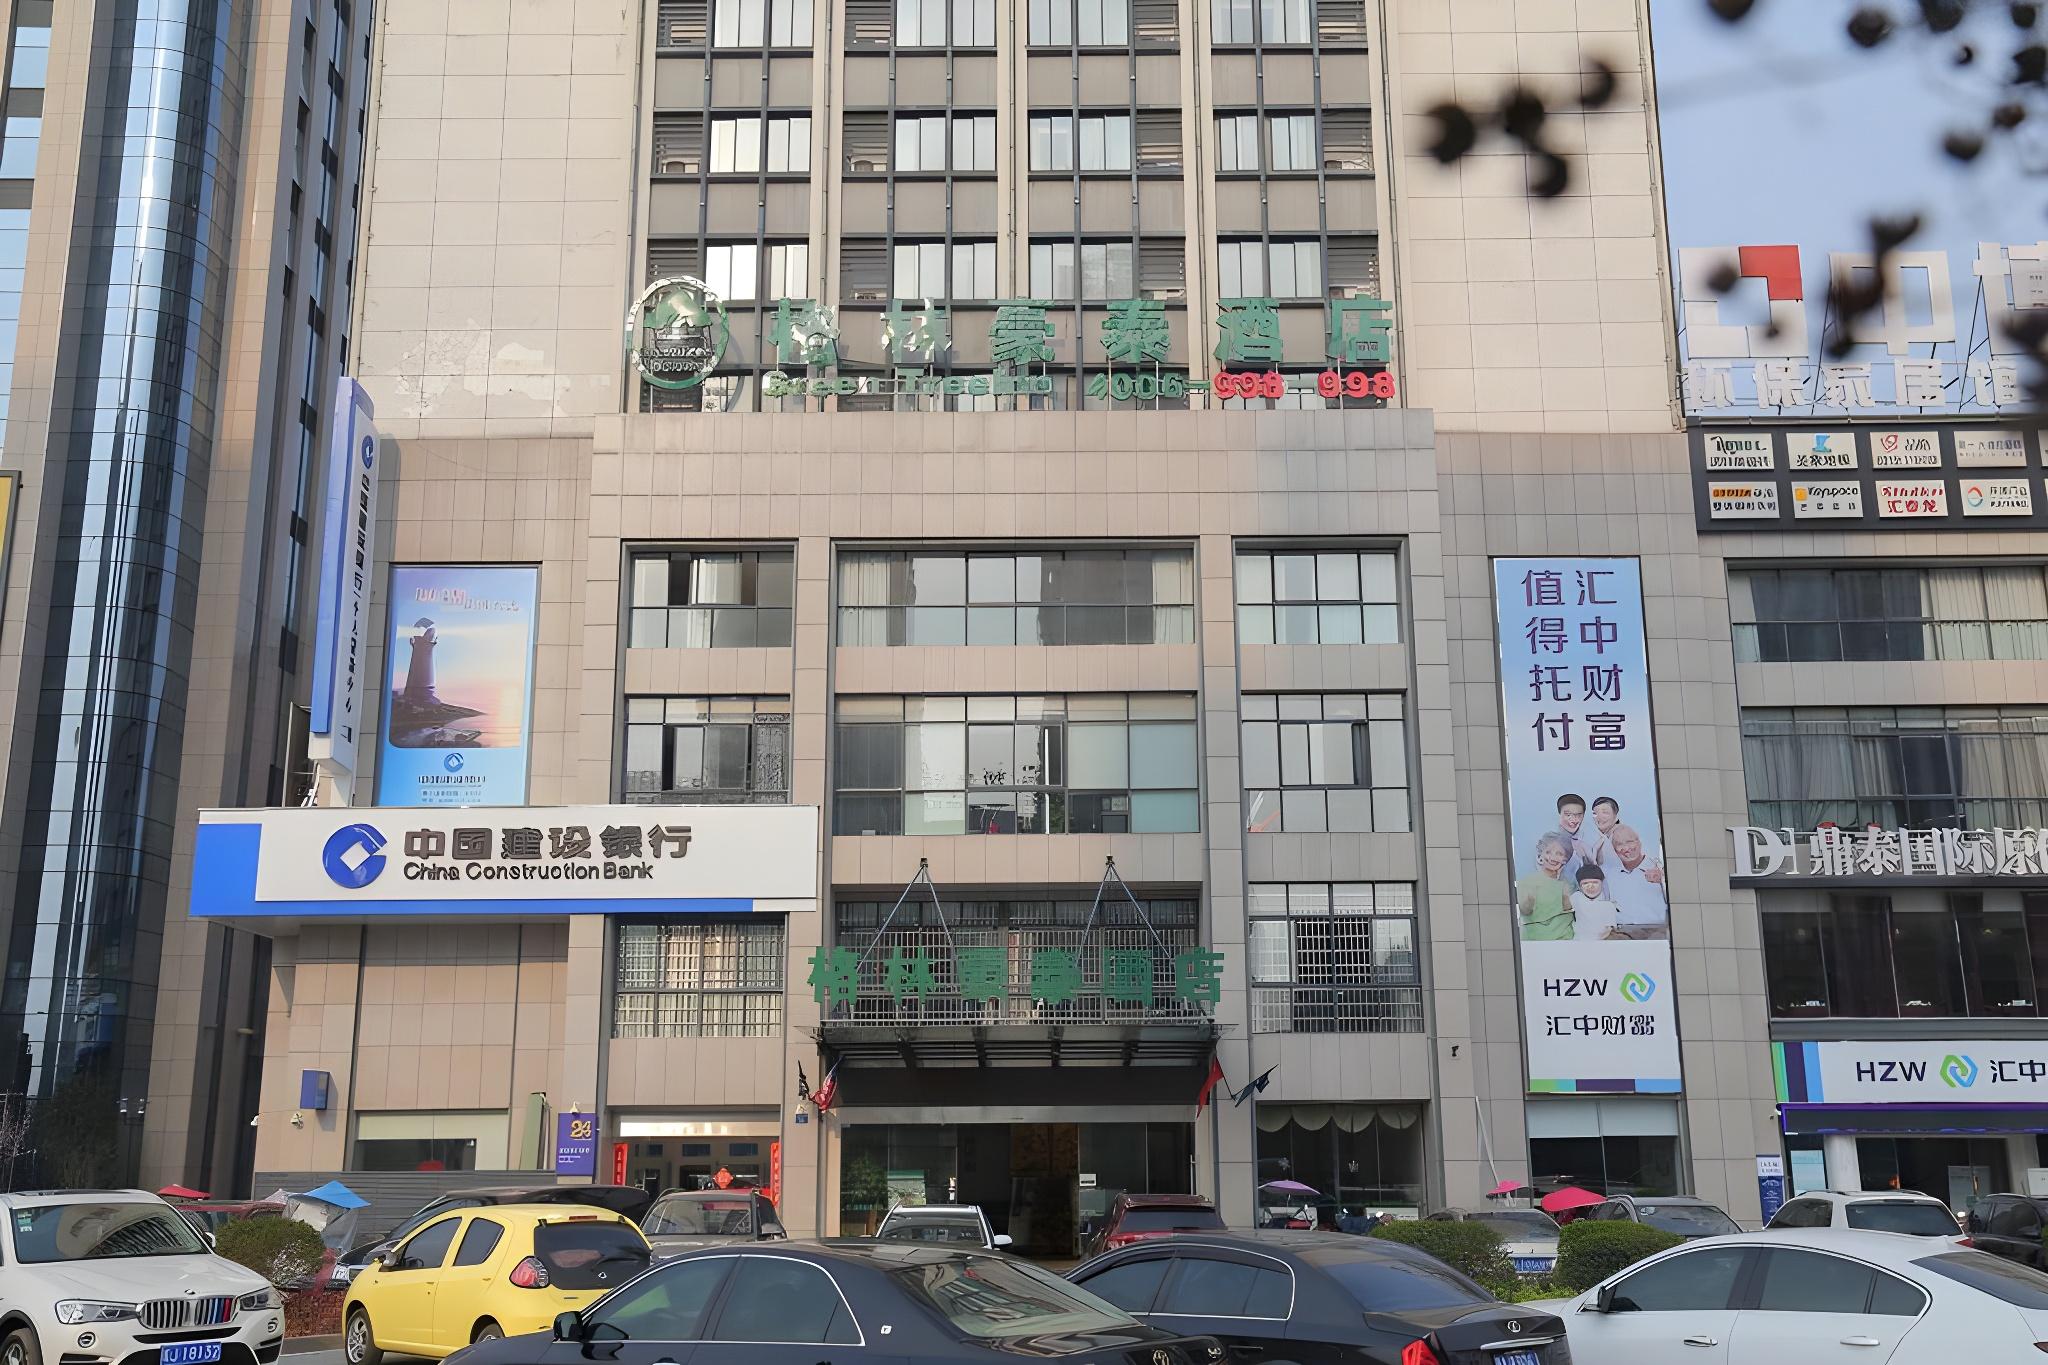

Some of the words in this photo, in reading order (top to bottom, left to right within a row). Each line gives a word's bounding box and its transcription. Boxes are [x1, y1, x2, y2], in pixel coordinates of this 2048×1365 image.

[1521, 569, 1574, 752] 值得托付
[1575, 569, 1626, 751] 汇中财富
[403, 823, 692, 861] 中国建设银行
[403, 861, 460, 881] China
[465, 861, 600, 881] Construction
[603, 860, 654, 880] Bank
[1543, 978, 1608, 997] HZW
[1856, 1061, 1926, 1082] HZW
[1990, 1059, 2047, 1083] 汇中
